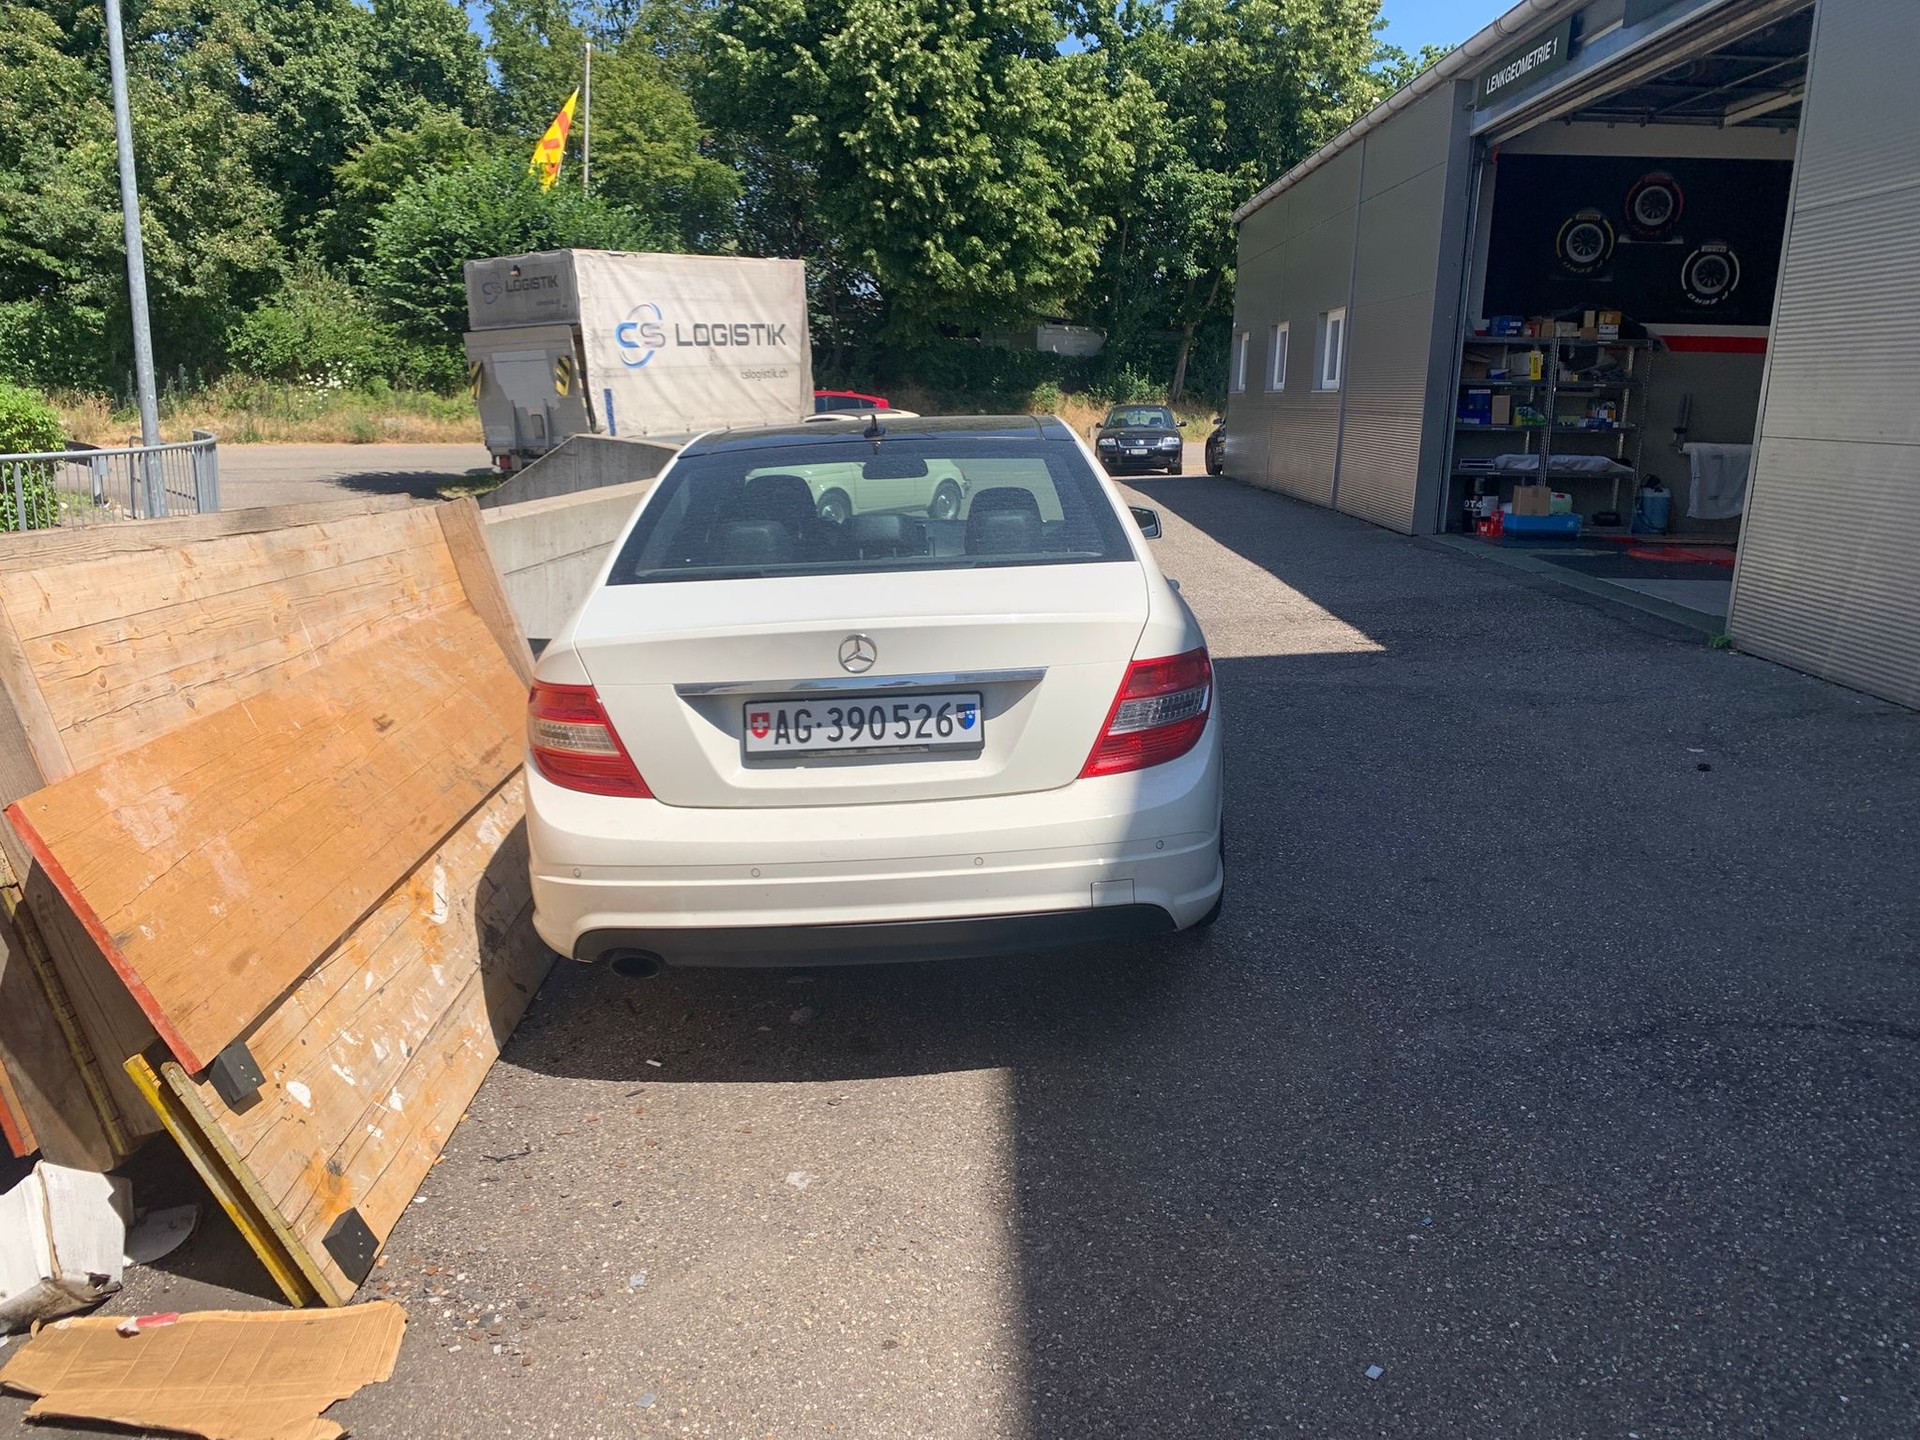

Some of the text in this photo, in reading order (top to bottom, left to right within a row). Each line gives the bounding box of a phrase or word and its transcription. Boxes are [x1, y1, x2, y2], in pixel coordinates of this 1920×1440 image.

[1486, 37, 1558, 94] LENKGEOMETRIE 1
[505, 275, 559, 292] LOGISTIK
[614, 321, 787, 348] CS LOGISTIK
